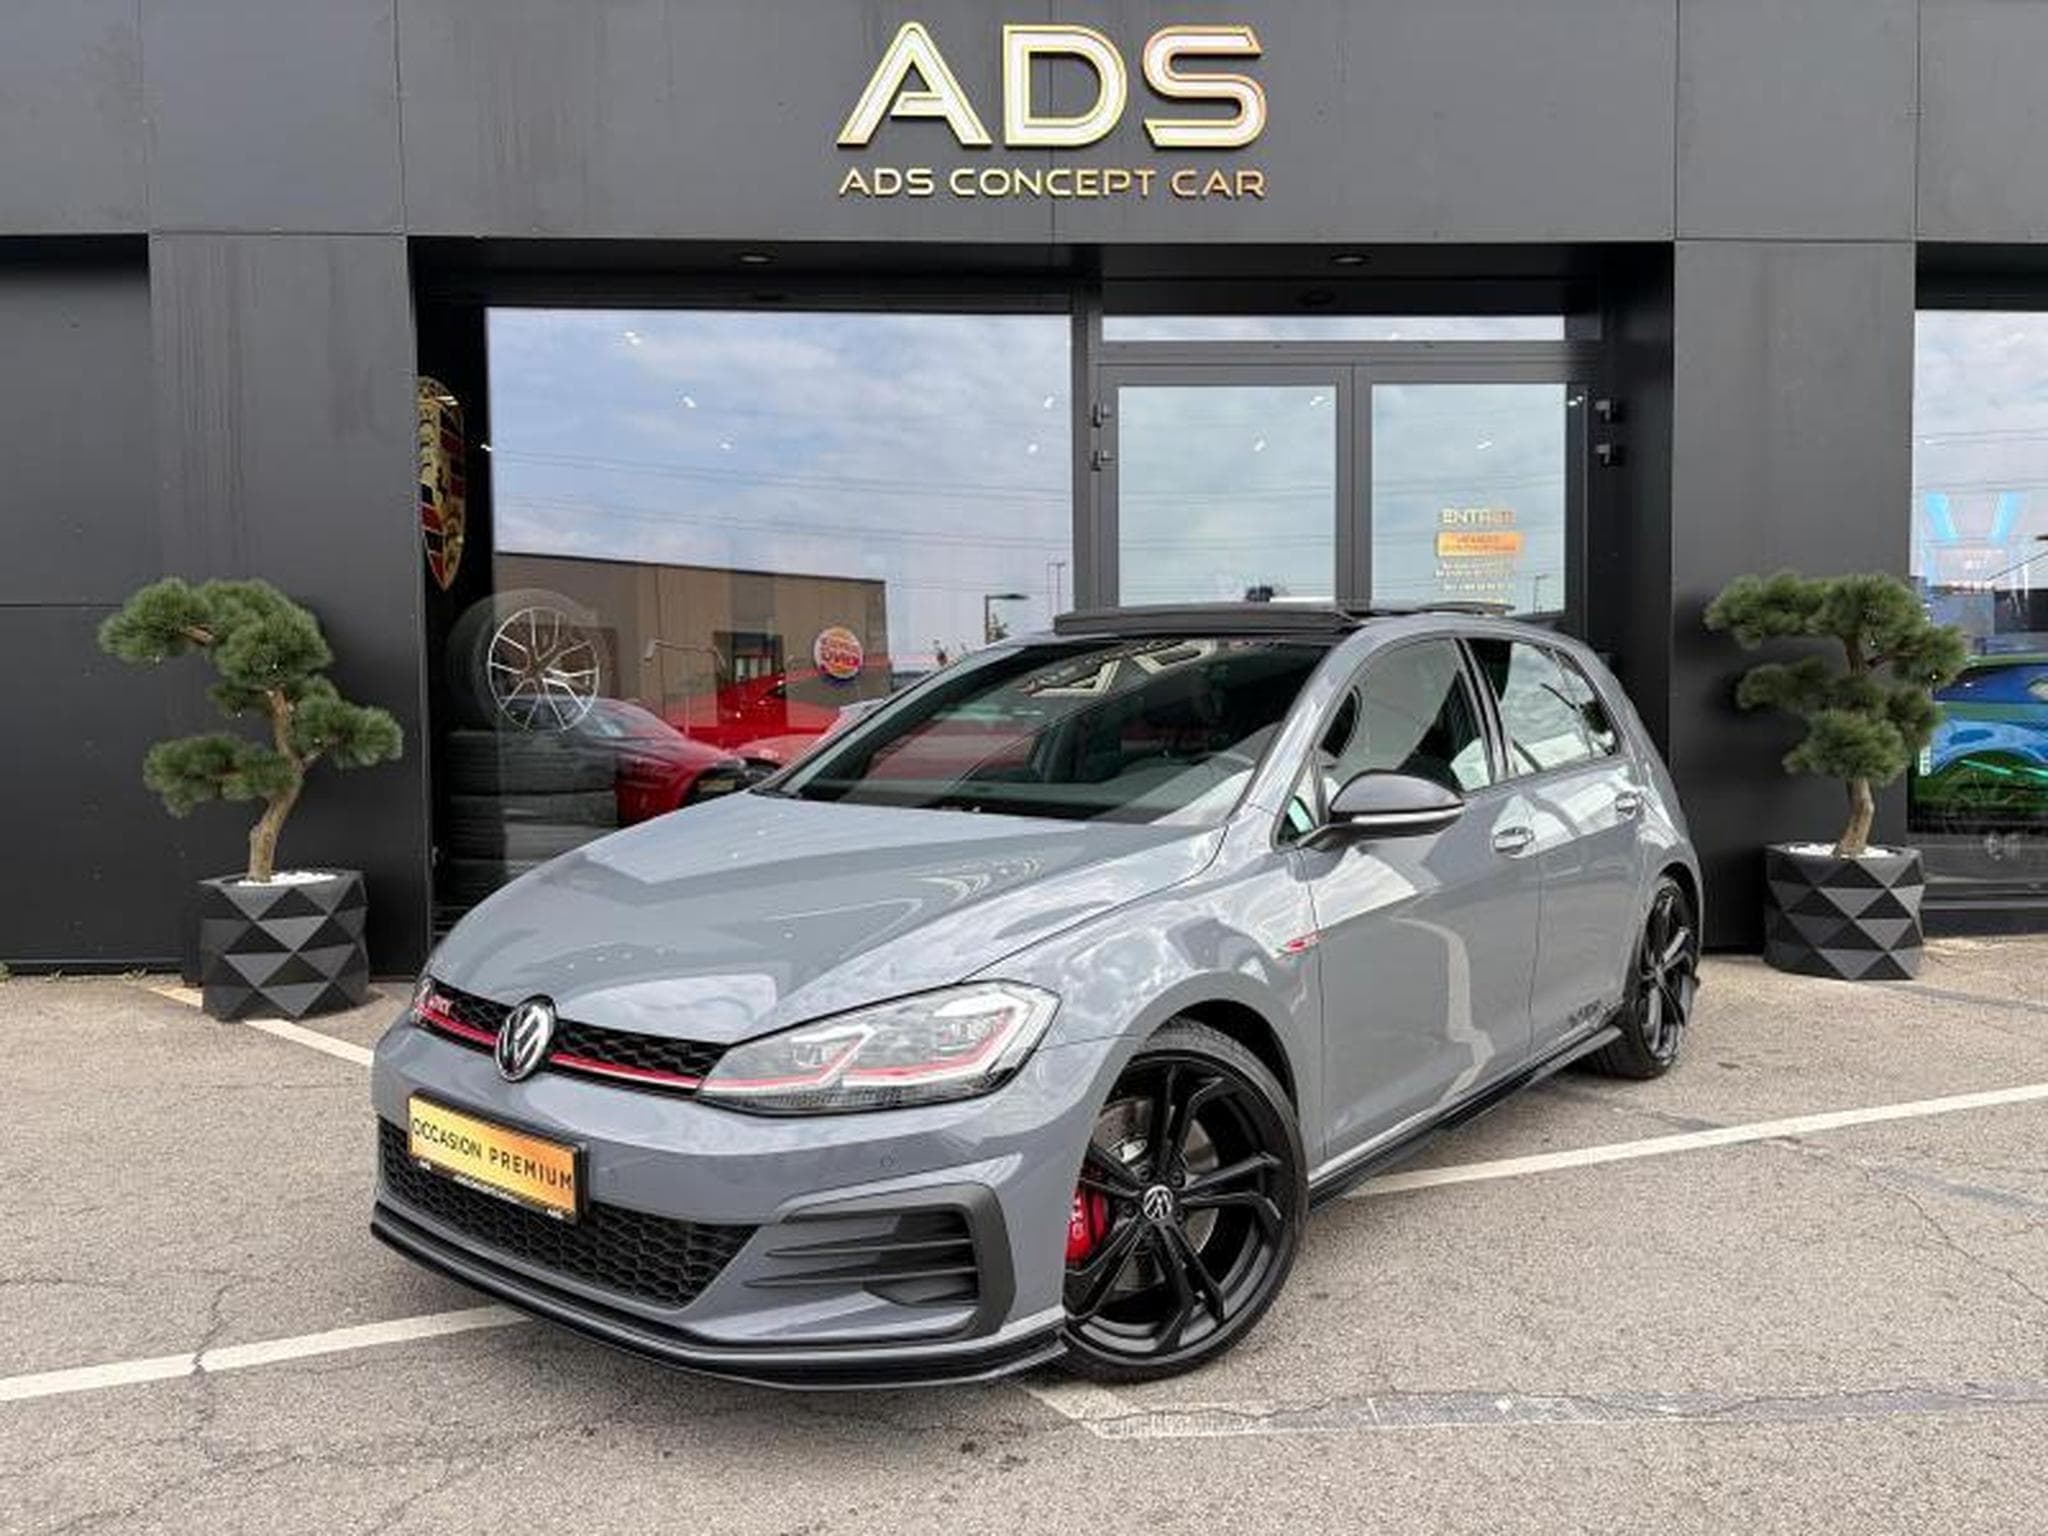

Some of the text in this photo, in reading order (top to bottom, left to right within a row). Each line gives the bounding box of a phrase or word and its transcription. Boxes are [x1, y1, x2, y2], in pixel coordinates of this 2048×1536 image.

[837, 21, 1267, 148] ADS
[839, 167, 1266, 198] ADS CONCEPT CAR
[411, 1117, 483, 1159] OCCASION
[489, 1146, 573, 1190] PREMIUM
